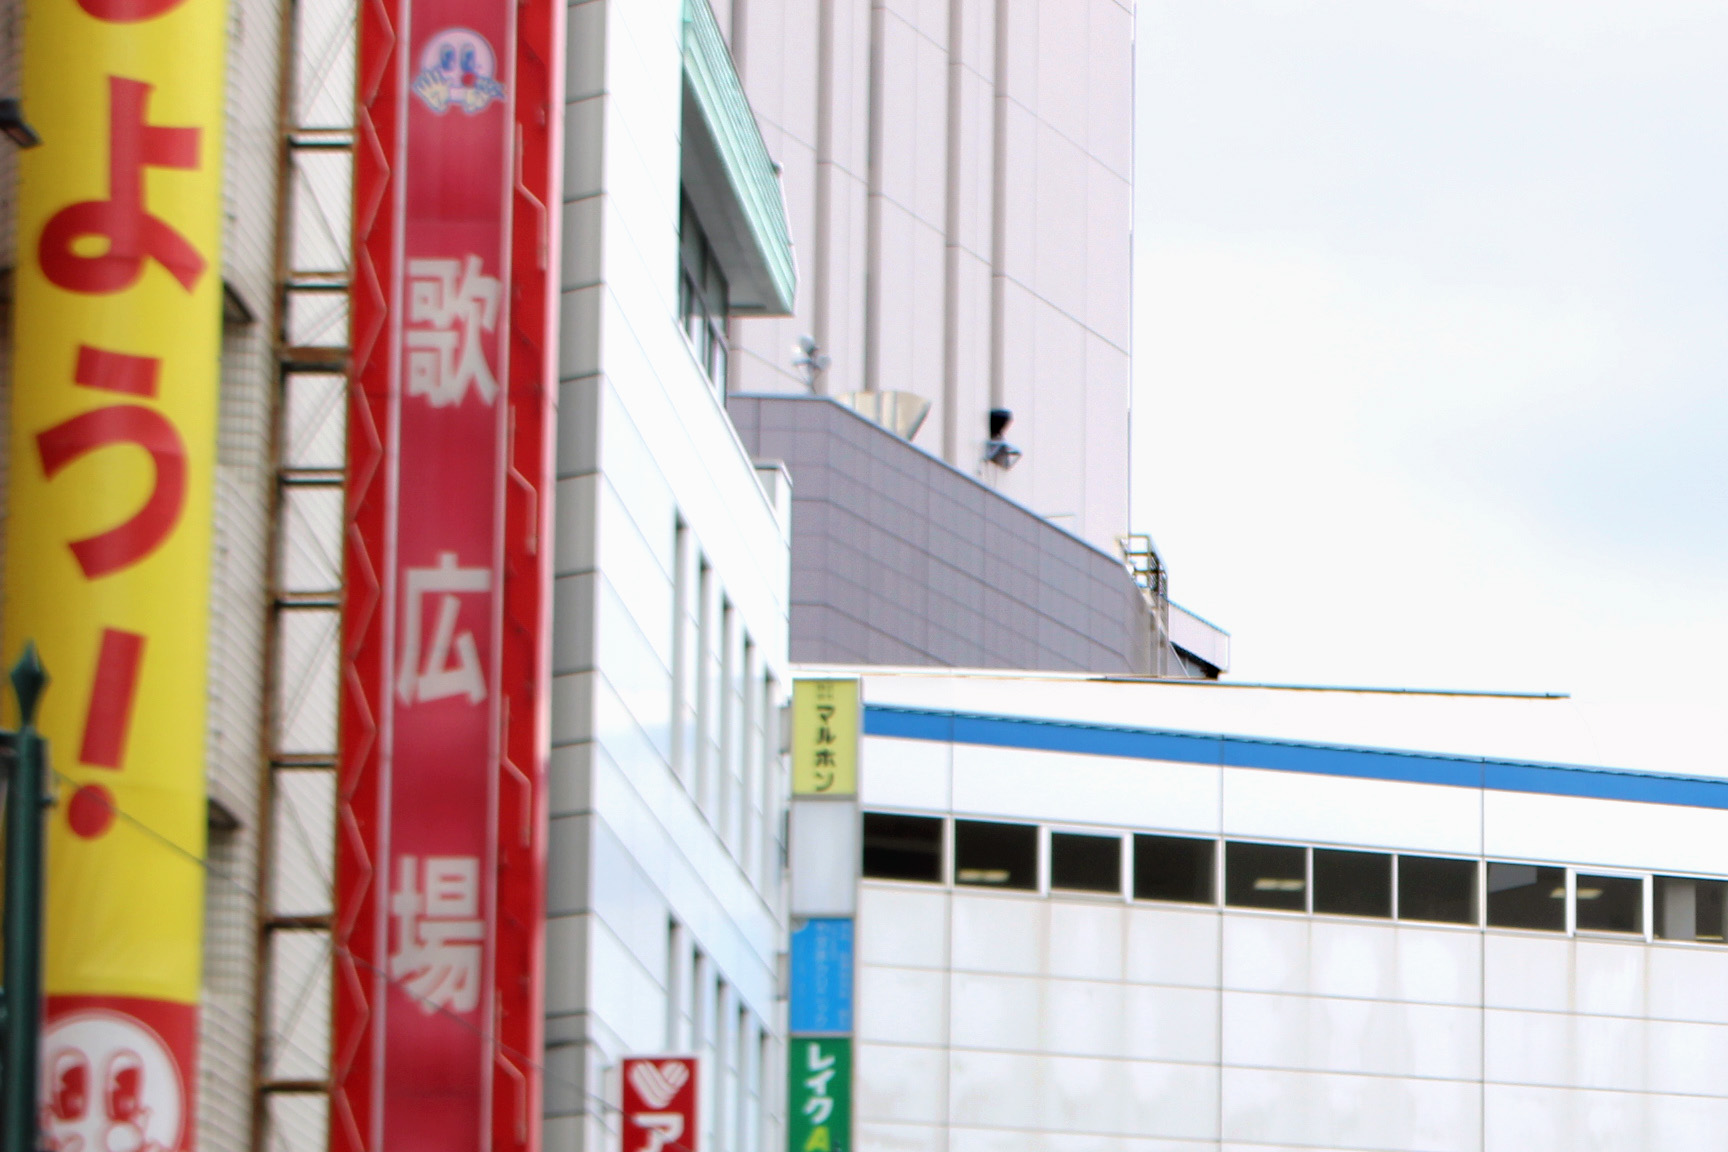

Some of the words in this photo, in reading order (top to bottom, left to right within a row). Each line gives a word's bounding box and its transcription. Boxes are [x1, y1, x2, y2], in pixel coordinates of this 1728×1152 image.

[36, 0, 207, 839] よう!
[815, 704, 836, 792] マルホン
